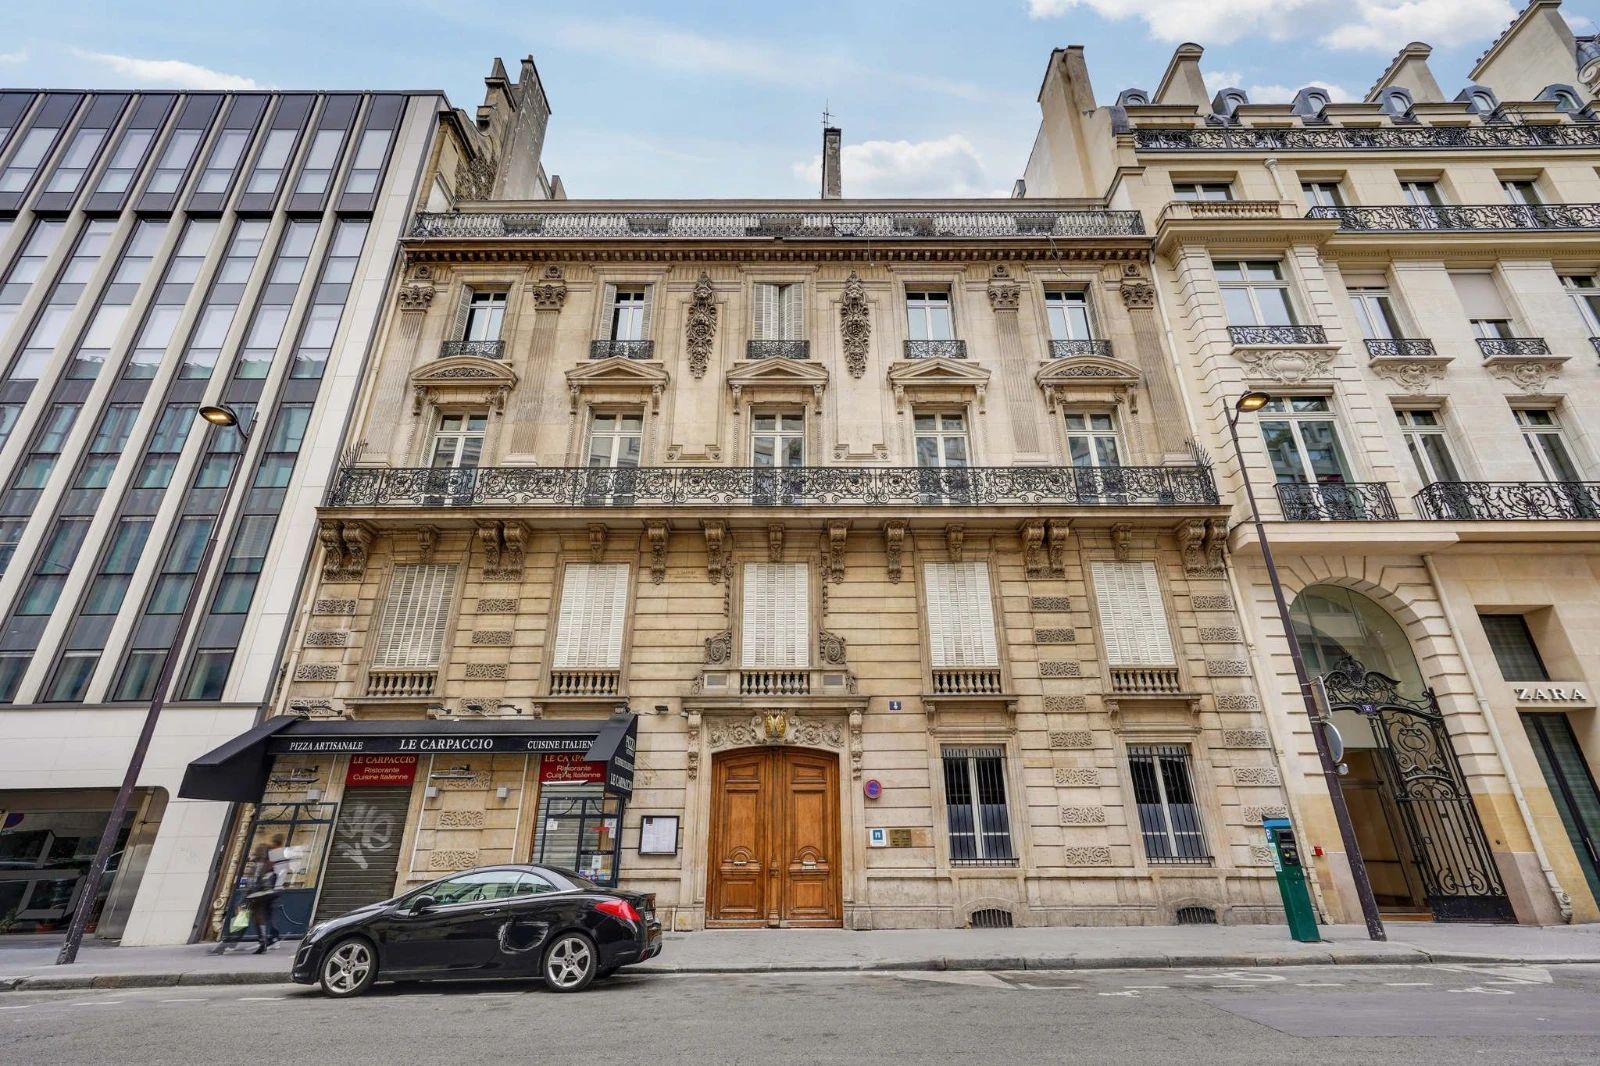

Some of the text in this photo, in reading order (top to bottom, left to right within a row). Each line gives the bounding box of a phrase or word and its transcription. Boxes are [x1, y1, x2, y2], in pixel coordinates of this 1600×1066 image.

[1513, 688, 1588, 701] ZARA
[289, 741, 364, 751] PIZZA ARTISANALE
[399, 738, 494, 750] LE CARPACCIO
[527, 740, 595, 750] CUISINE ITALIEN
[352, 756, 416, 764] LE CARPACCIO
[544, 754, 555, 762] LE
